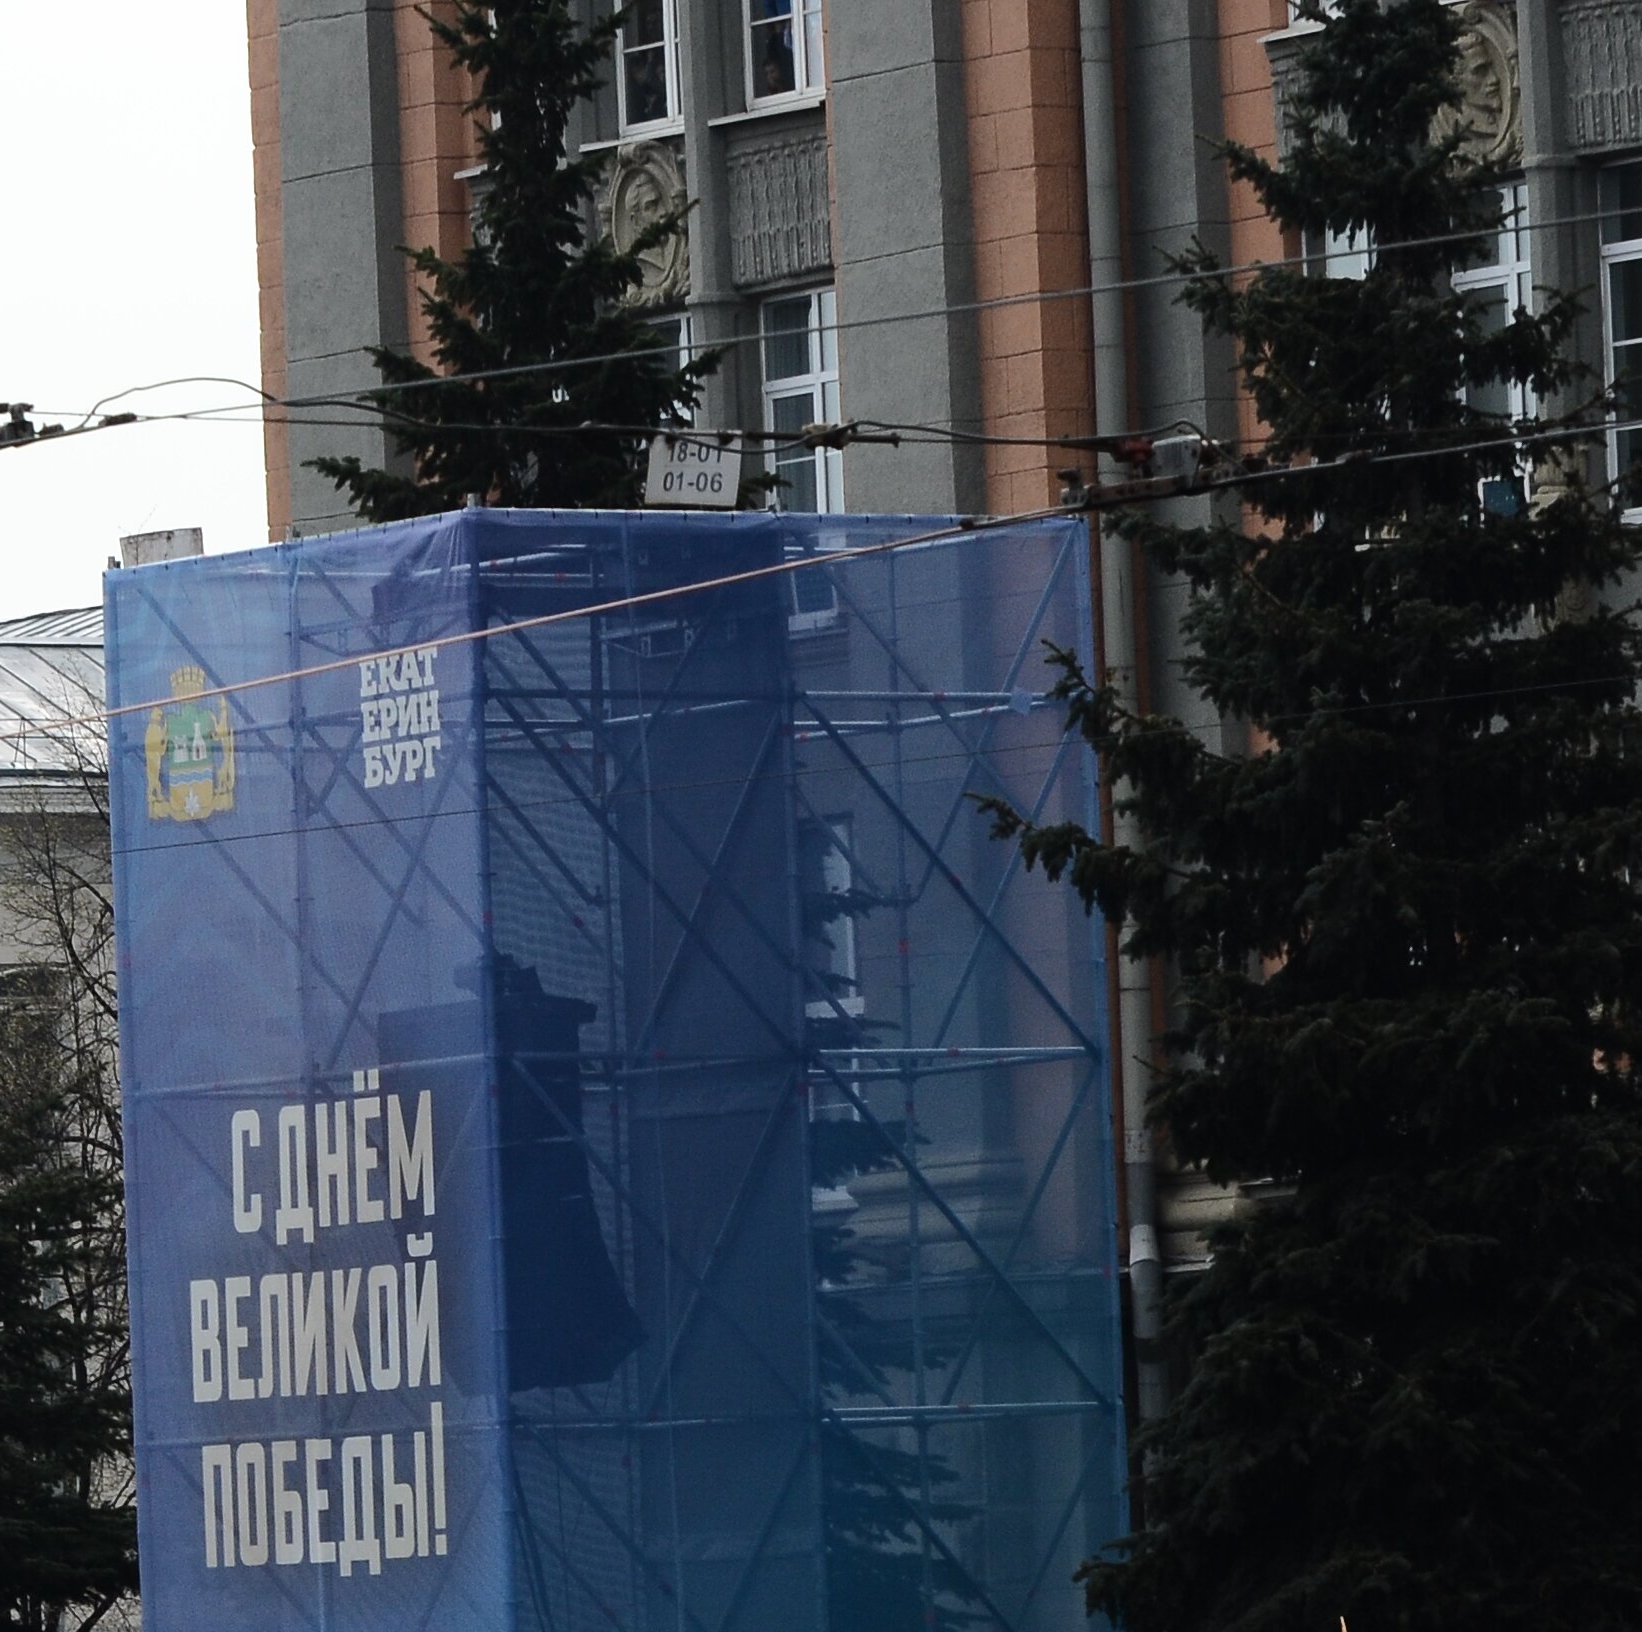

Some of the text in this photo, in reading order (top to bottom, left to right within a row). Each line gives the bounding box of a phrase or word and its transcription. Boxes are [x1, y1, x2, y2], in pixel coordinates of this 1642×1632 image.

[663, 472, 723, 493] 01-06
[359, 646, 438, 697] ЕКАТ
[361, 690, 441, 742] ЕРИН
[363, 736, 442, 788] БУРГ
[231, 1069, 435, 1245] С ДНЁМ
[190, 1232, 441, 1402] ВЕЛИКОЙ
[202, 1401, 447, 1577] ПОБЕДЫ!
